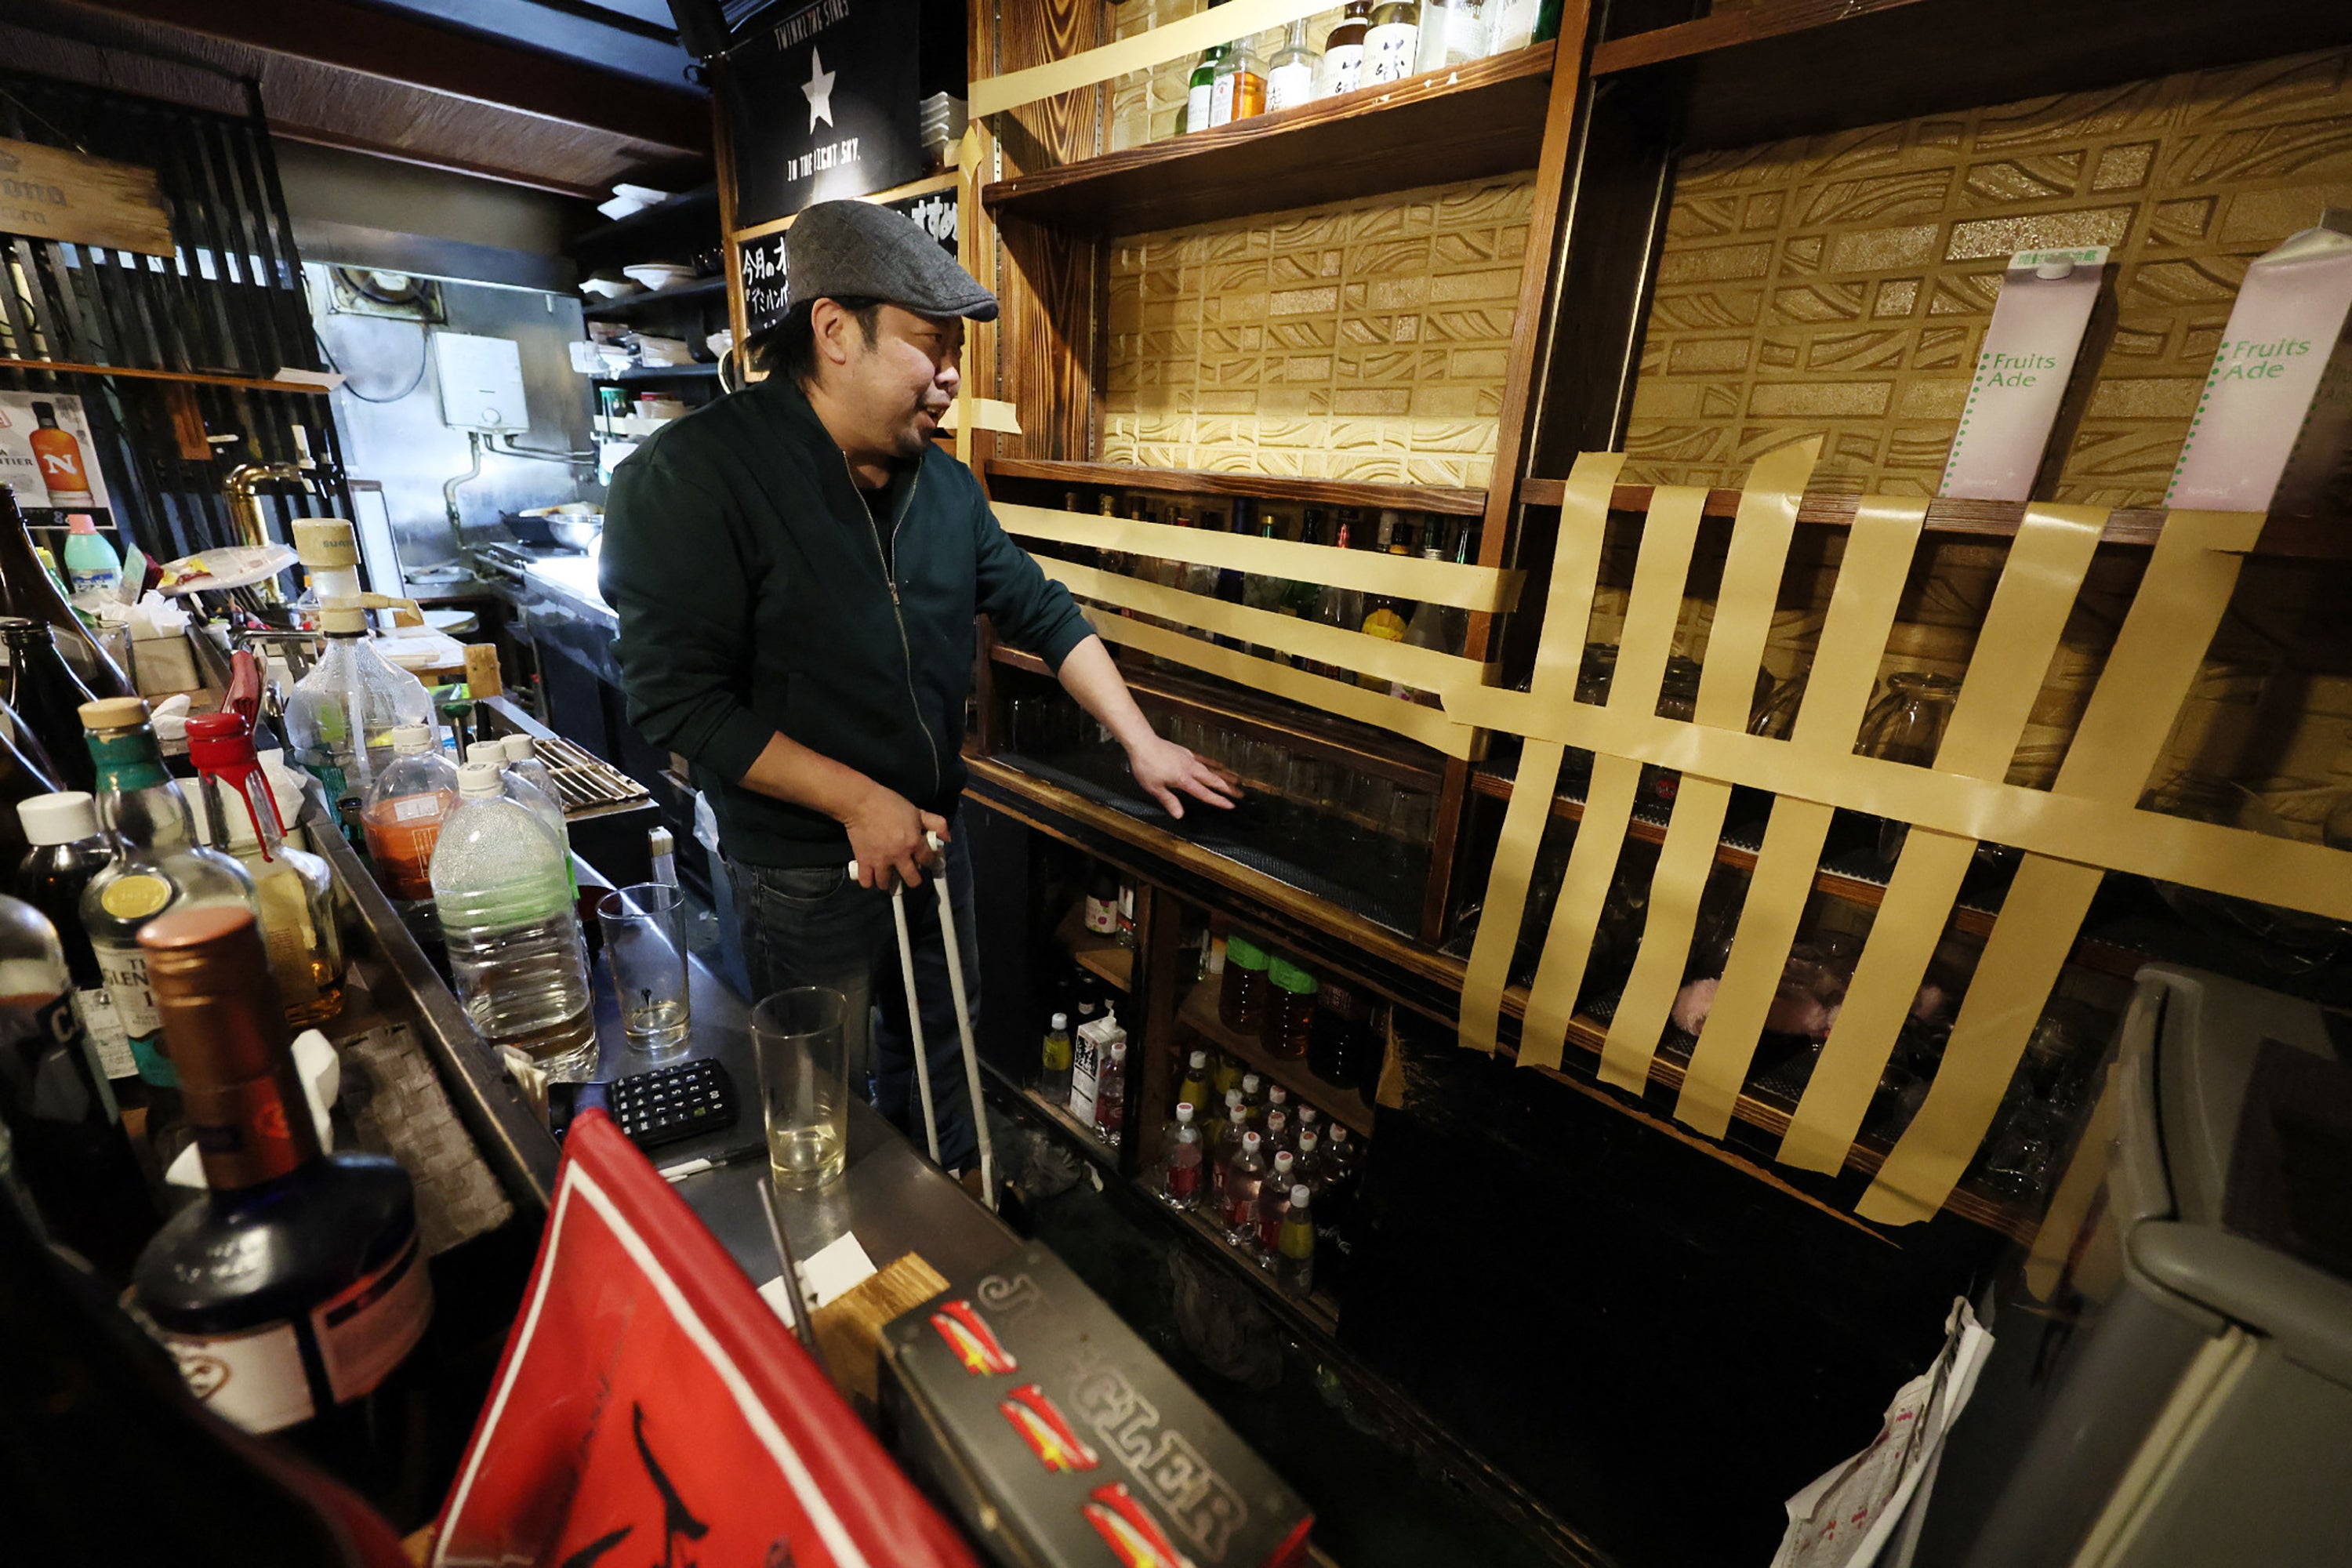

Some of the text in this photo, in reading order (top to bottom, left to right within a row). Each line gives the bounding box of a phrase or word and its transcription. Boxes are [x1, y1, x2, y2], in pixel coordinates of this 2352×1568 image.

[2233, 338, 2311, 359] Fruits
[1993, 354, 2056, 370] Fruits
[2223, 360, 2285, 381] Ade
[1987, 372, 2037, 387] Ade
[43, 453, 78, 475] N
